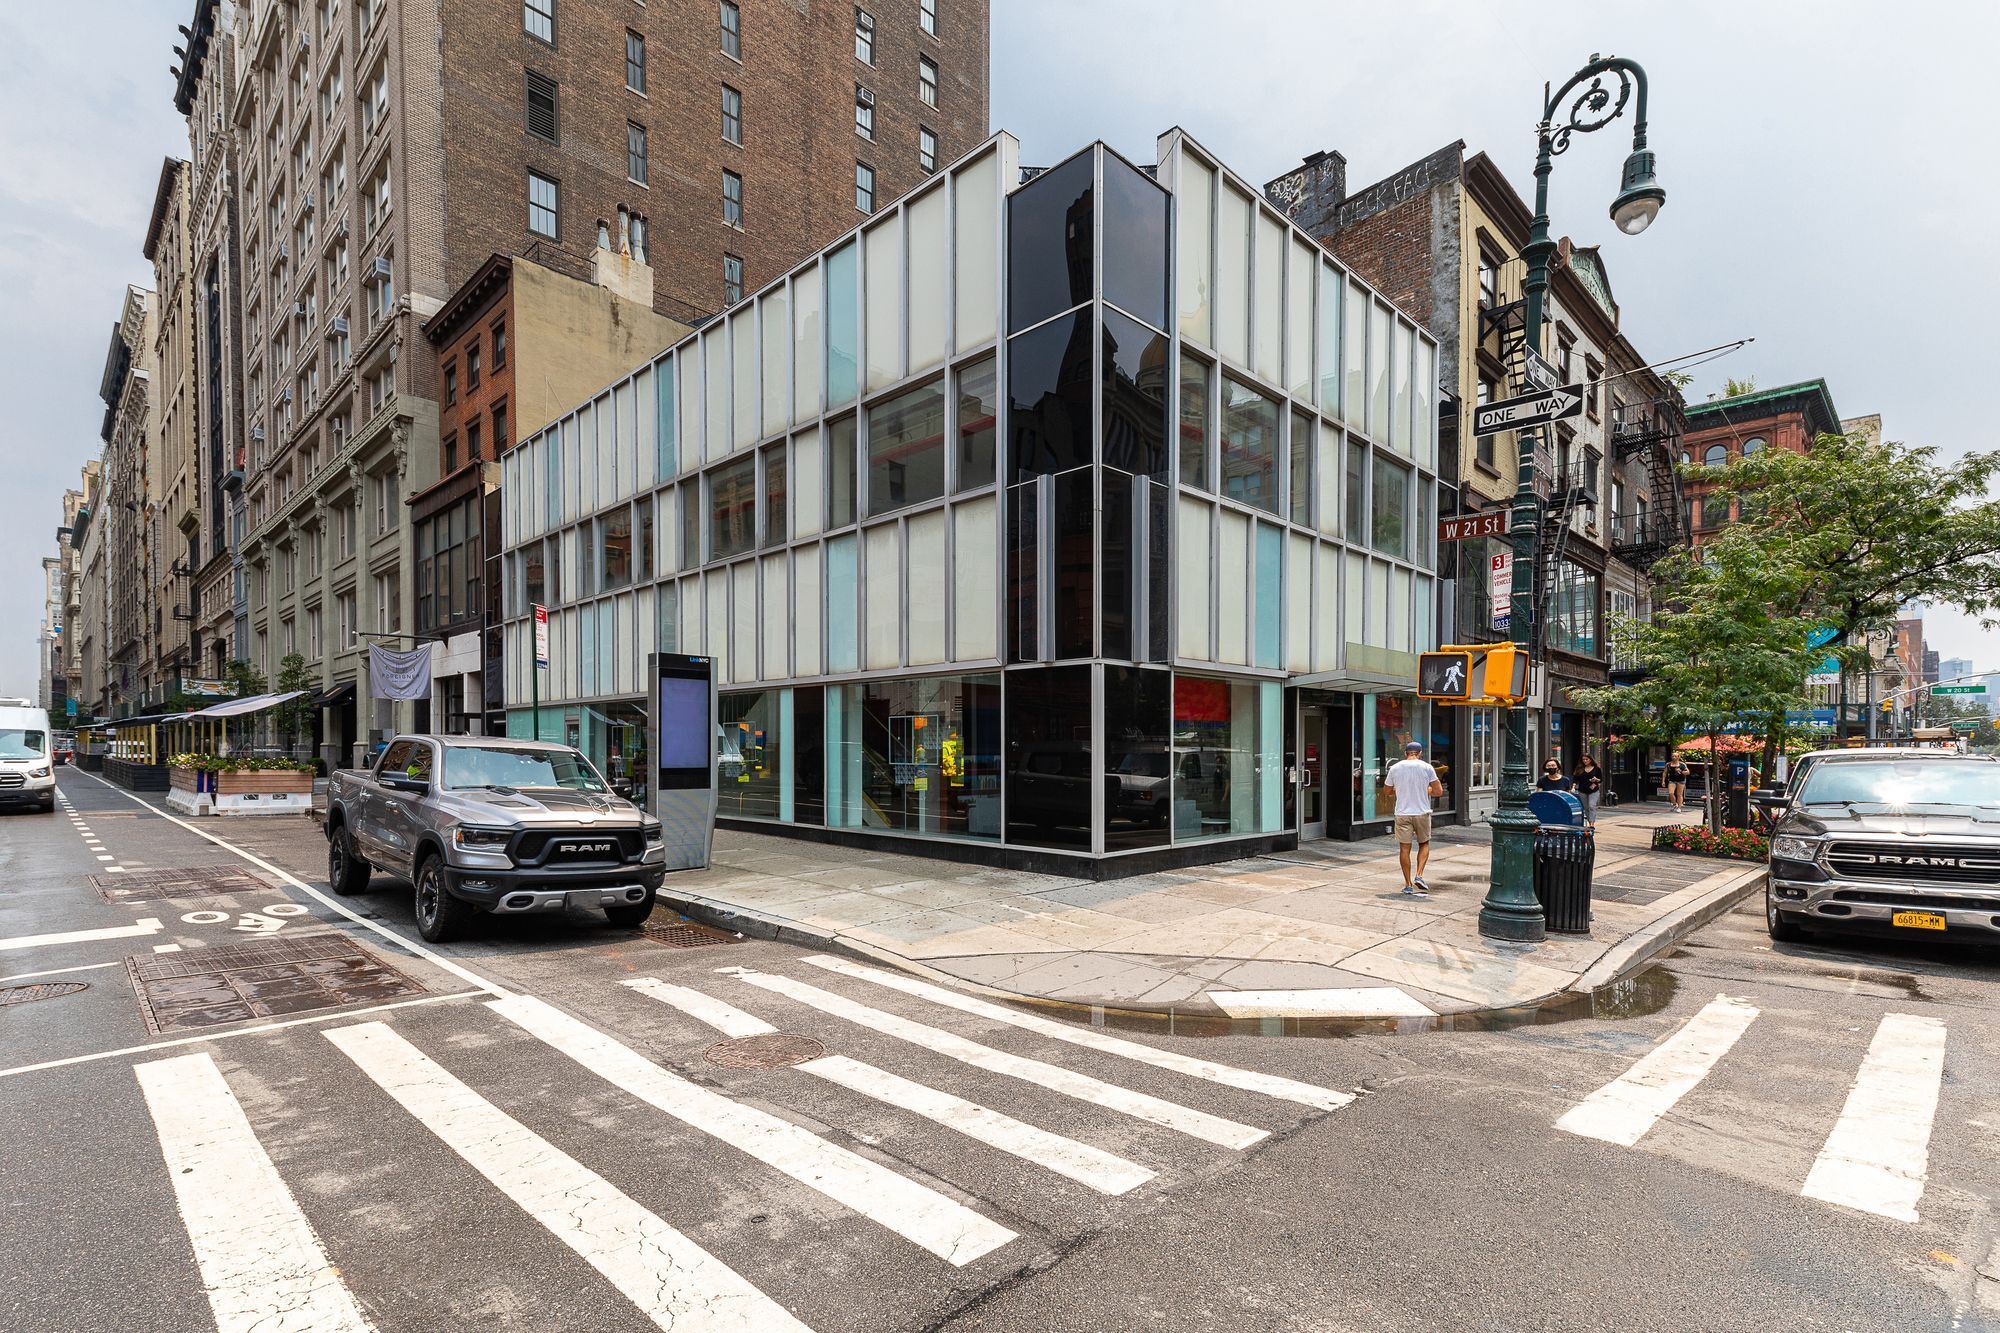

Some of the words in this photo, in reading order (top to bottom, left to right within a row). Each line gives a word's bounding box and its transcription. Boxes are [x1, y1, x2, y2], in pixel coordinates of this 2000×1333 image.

[1393, 158, 1438, 201] FACE
[1482, 408, 1516, 425] ONE
[1535, 396, 1570, 414] WAY
[1446, 523, 1458, 539] W
[1464, 521, 1478, 536] 21
[1484, 515, 1499, 533] St
[1495, 556, 1502, 569] 3
[1494, 572, 1511, 581] COMMER
[1494, 578, 1511, 587] VEHICLE
[1494, 619, 1510, 629] 1033
[1736, 766, 1745, 776] P
[560, 844, 611, 852] RAM
[1879, 855, 1956, 866] RAM
